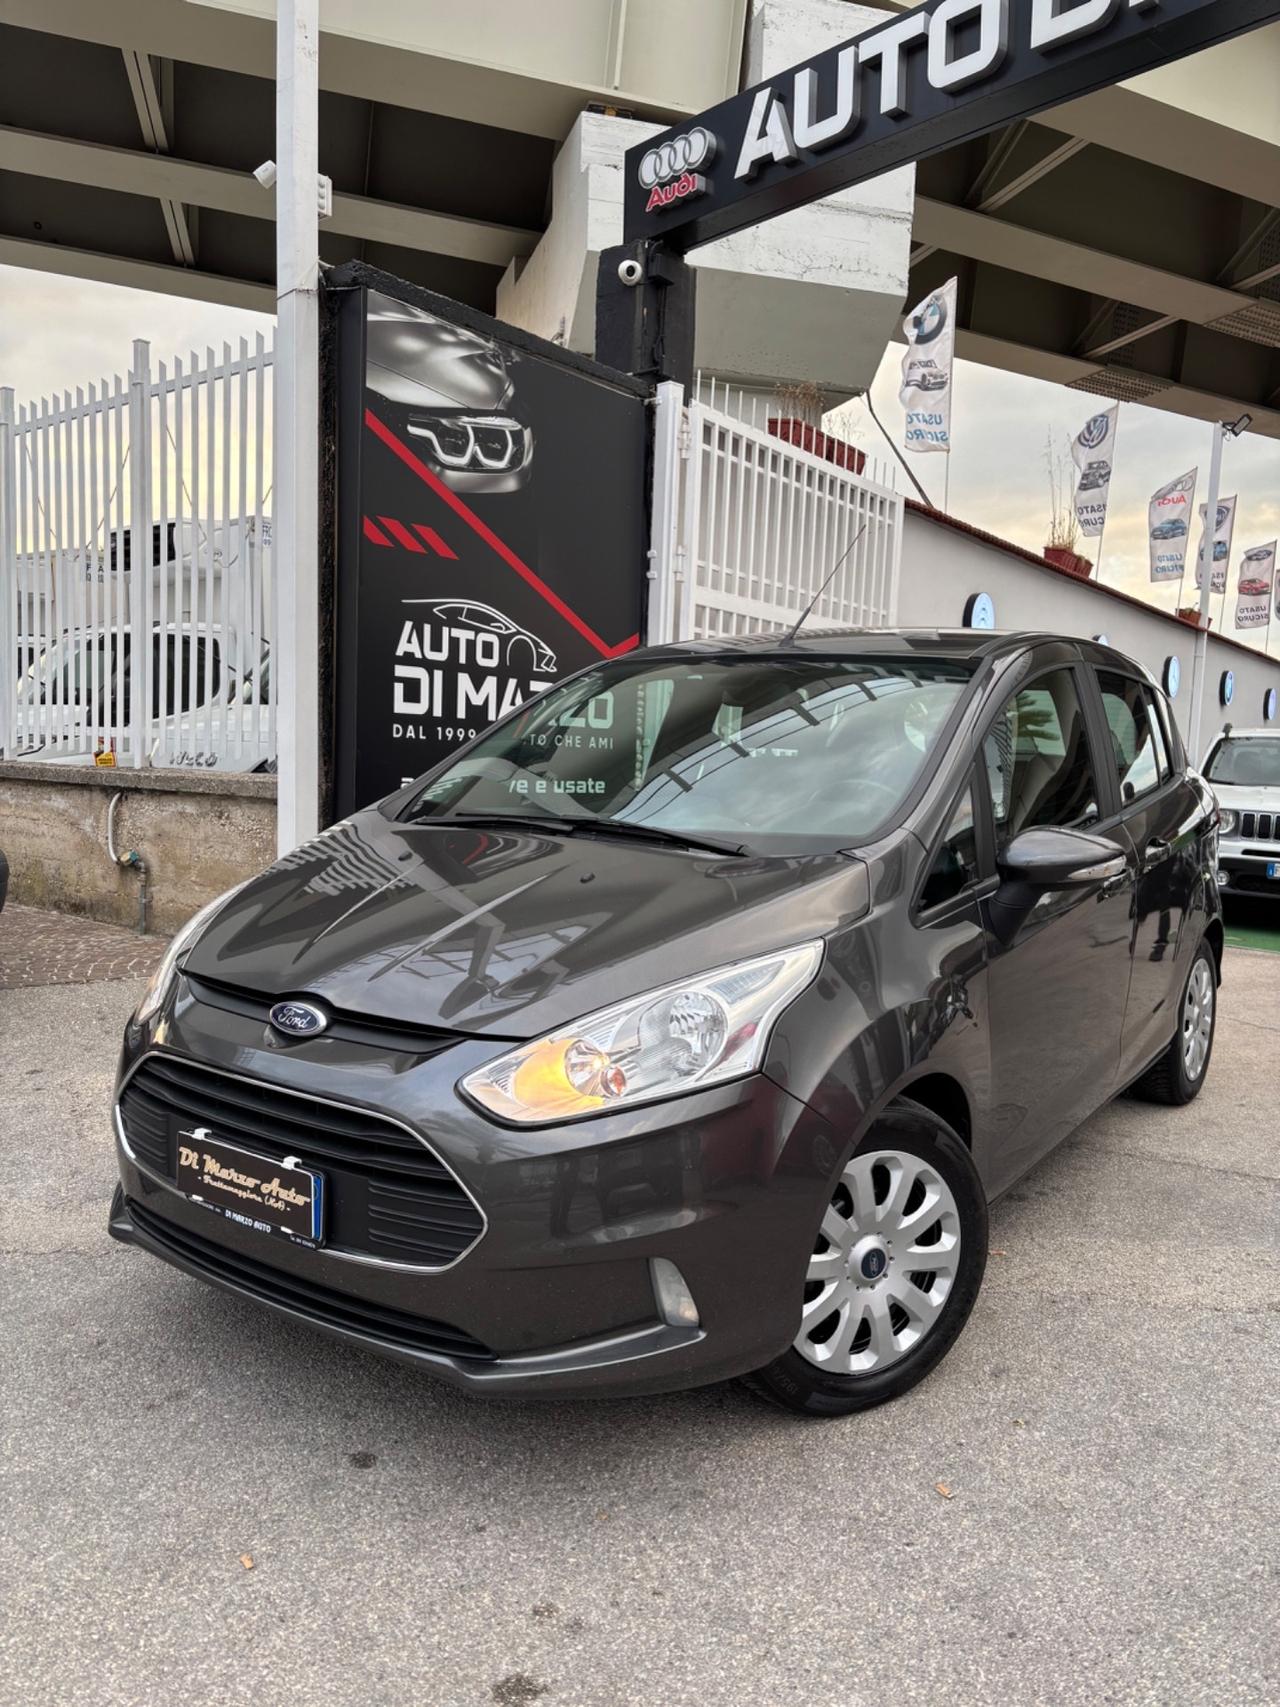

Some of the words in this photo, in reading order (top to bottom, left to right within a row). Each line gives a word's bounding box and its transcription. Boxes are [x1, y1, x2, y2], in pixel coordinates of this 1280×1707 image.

[734, 0, 1001, 181] AUTO
[395, 620, 500, 668] AUTO
[393, 664, 444, 719] DI
[392, 723, 427, 740] DAL
[436, 726, 477, 741] 1999
[554, 734, 582, 748] CHE
[588, 736, 614, 750] AMI
[554, 778, 606, 794] usate
[278, 1006, 312, 1028] Ford
[179, 1146, 199, 1170] Di
[203, 1153, 262, 1188] Marzo
[260, 1177, 311, 1206] Auto
[232, 1211, 253, 1227] MARZO
